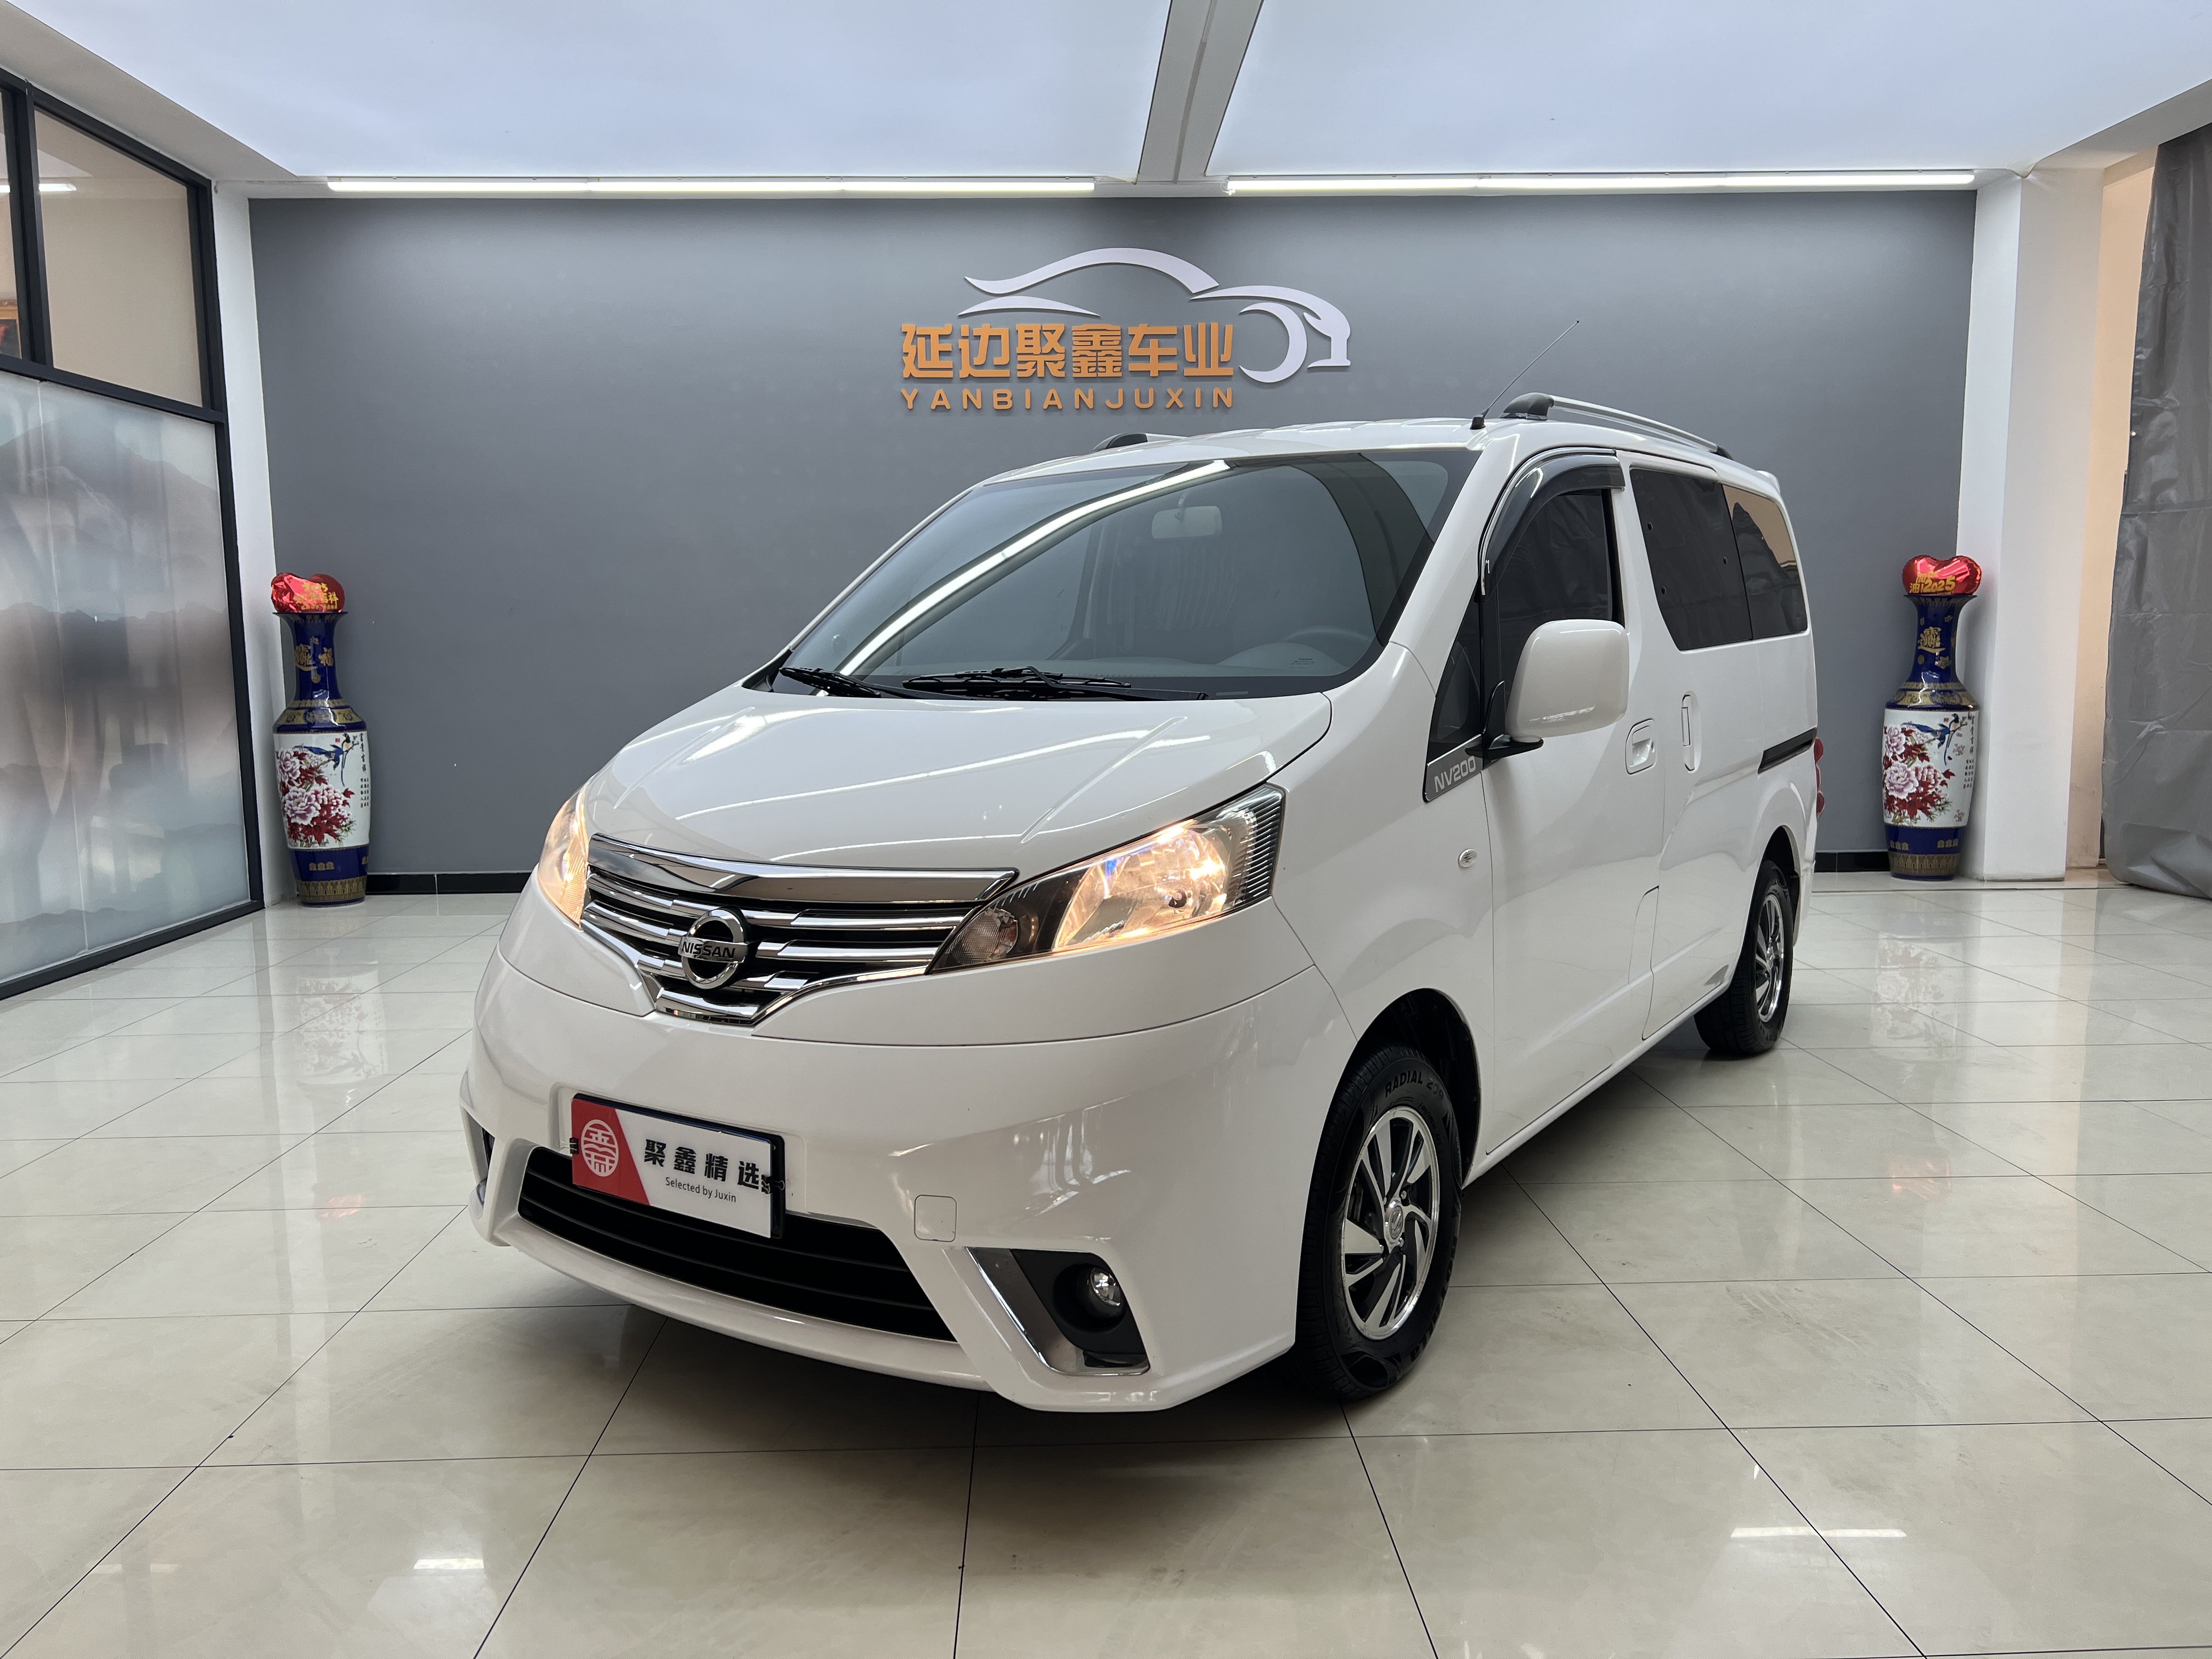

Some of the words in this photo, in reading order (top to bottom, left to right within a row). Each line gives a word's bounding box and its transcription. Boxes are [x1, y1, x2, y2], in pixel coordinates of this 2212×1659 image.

[901, 322, 1233, 378] 延边聚鑫车业
[901, 387, 1232, 410] YANBIANJUXIN
[1922, 576, 1956, 593] 2025
[1434, 755, 1476, 793] NV200
[681, 941, 736, 958] NISSAN
[1385, 1070, 1423, 1098] RADIAL
[644, 1139, 760, 1189] 聚鑫精选
[665, 1177, 701, 1194] Selected
[702, 1182, 713, 1198] by
[714, 1189, 736, 1203] Juxin
